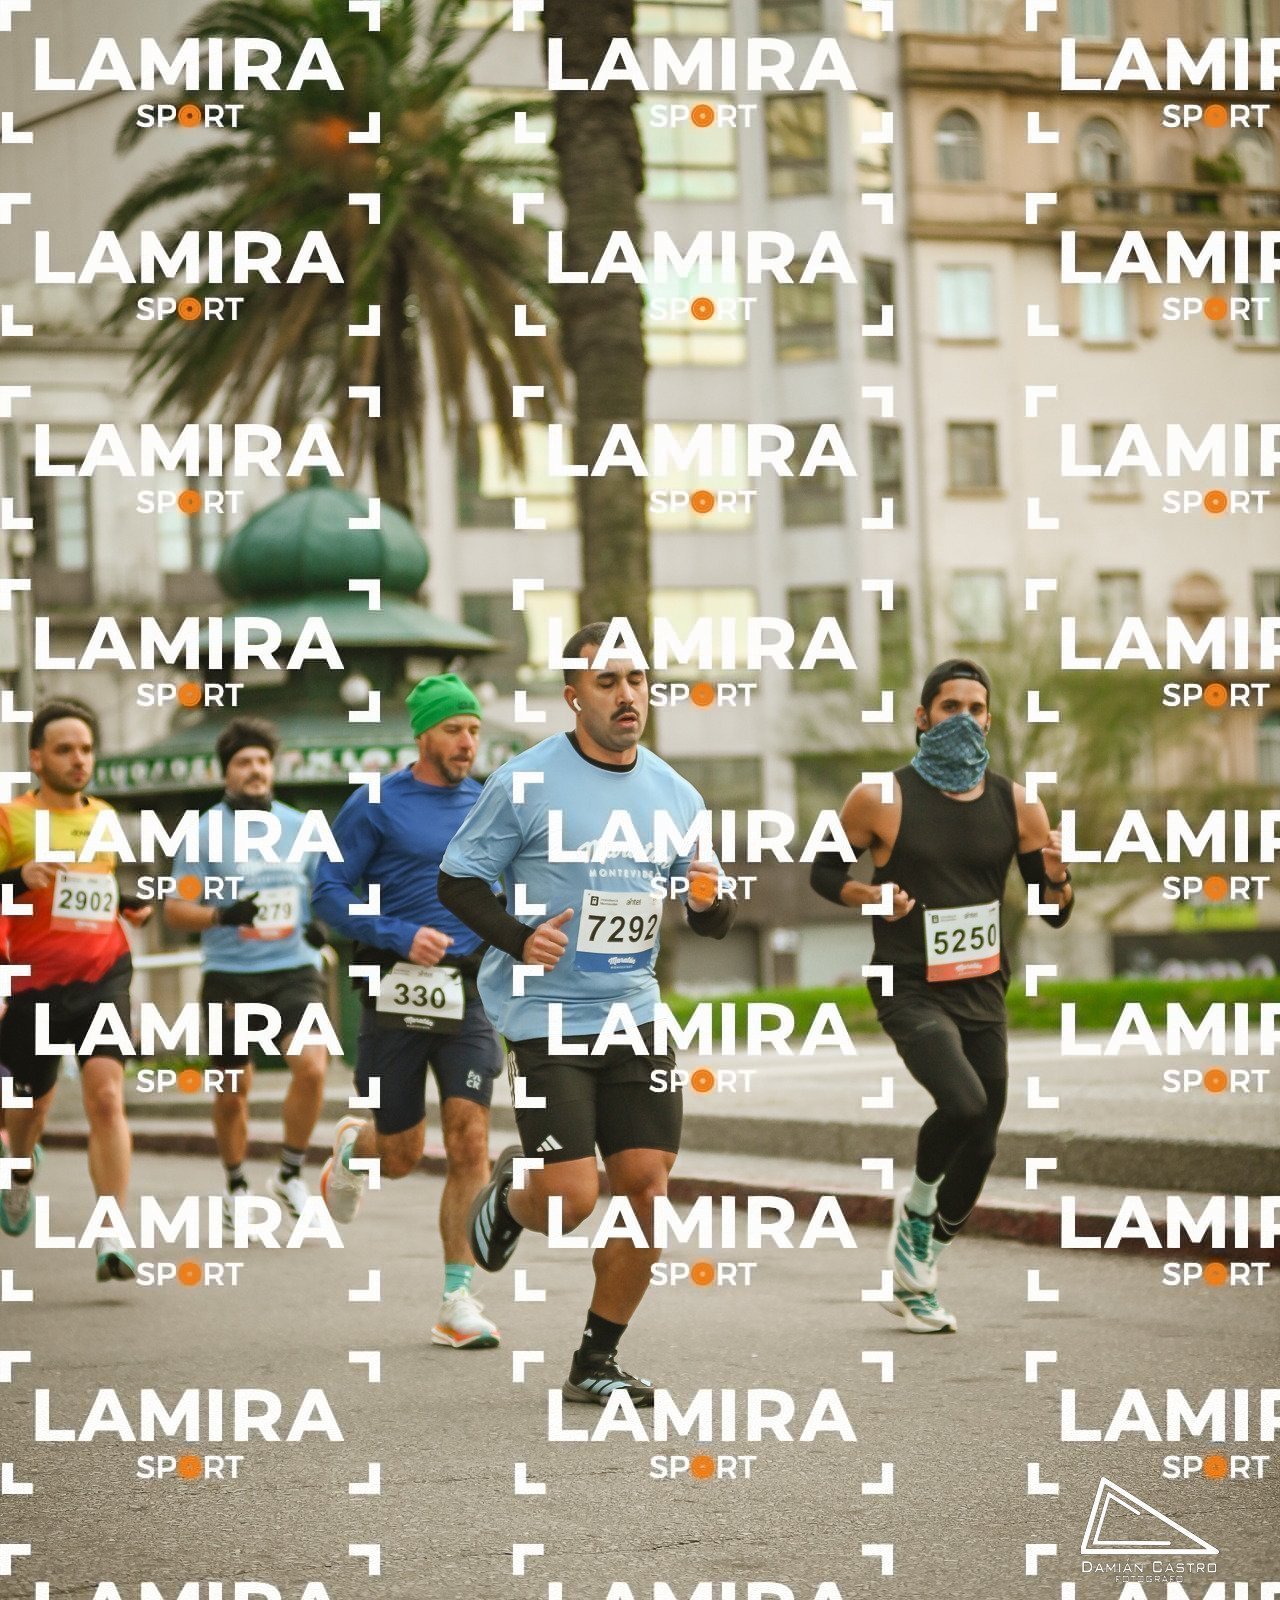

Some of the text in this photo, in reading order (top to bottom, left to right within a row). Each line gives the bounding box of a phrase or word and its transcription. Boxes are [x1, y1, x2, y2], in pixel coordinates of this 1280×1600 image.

[58, 888, 113, 912] 2902
[257, 902, 292, 921] 279
[587, 914, 658, 943] 7292
[934, 923, 997, 955] 5250
[393, 982, 446, 1009] 330
